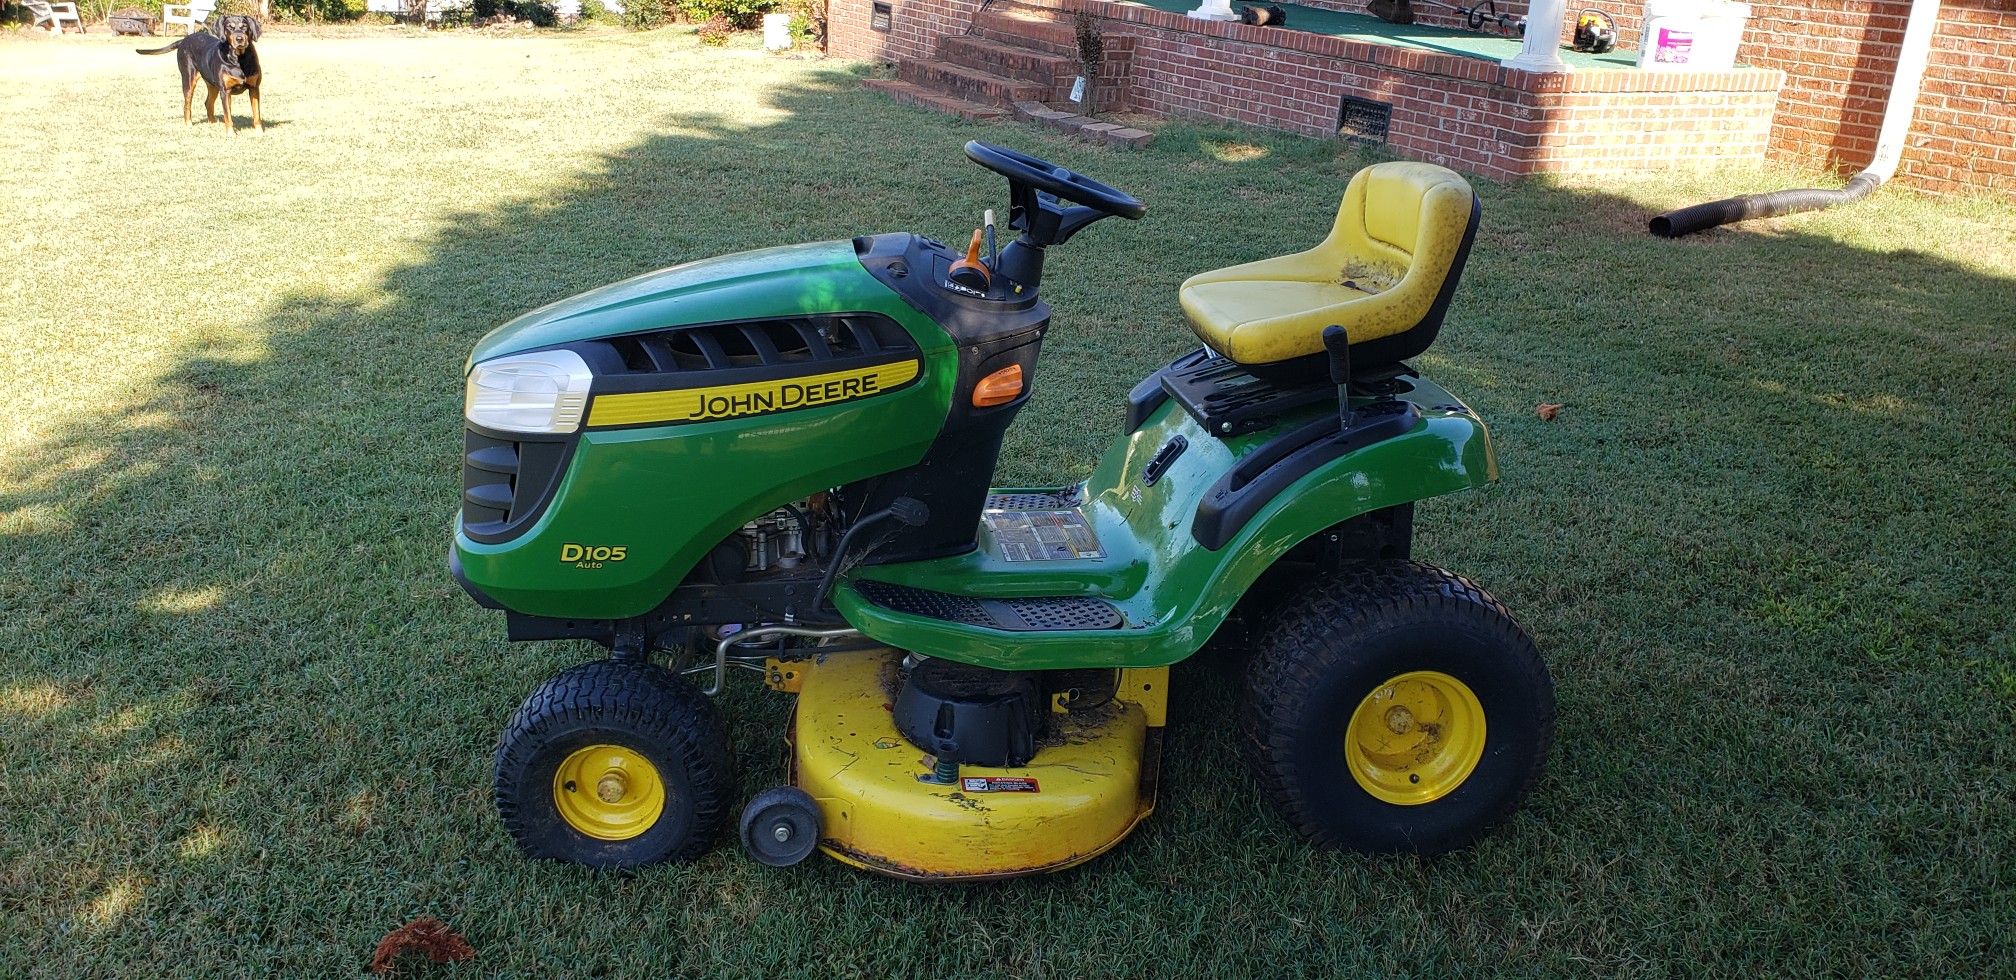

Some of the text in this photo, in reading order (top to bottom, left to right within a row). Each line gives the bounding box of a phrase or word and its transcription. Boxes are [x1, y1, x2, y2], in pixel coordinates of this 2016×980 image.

[690, 373, 878, 417] JOHN DEERE
[561, 544, 626, 561] D105
[576, 561, 602, 569] Auto
